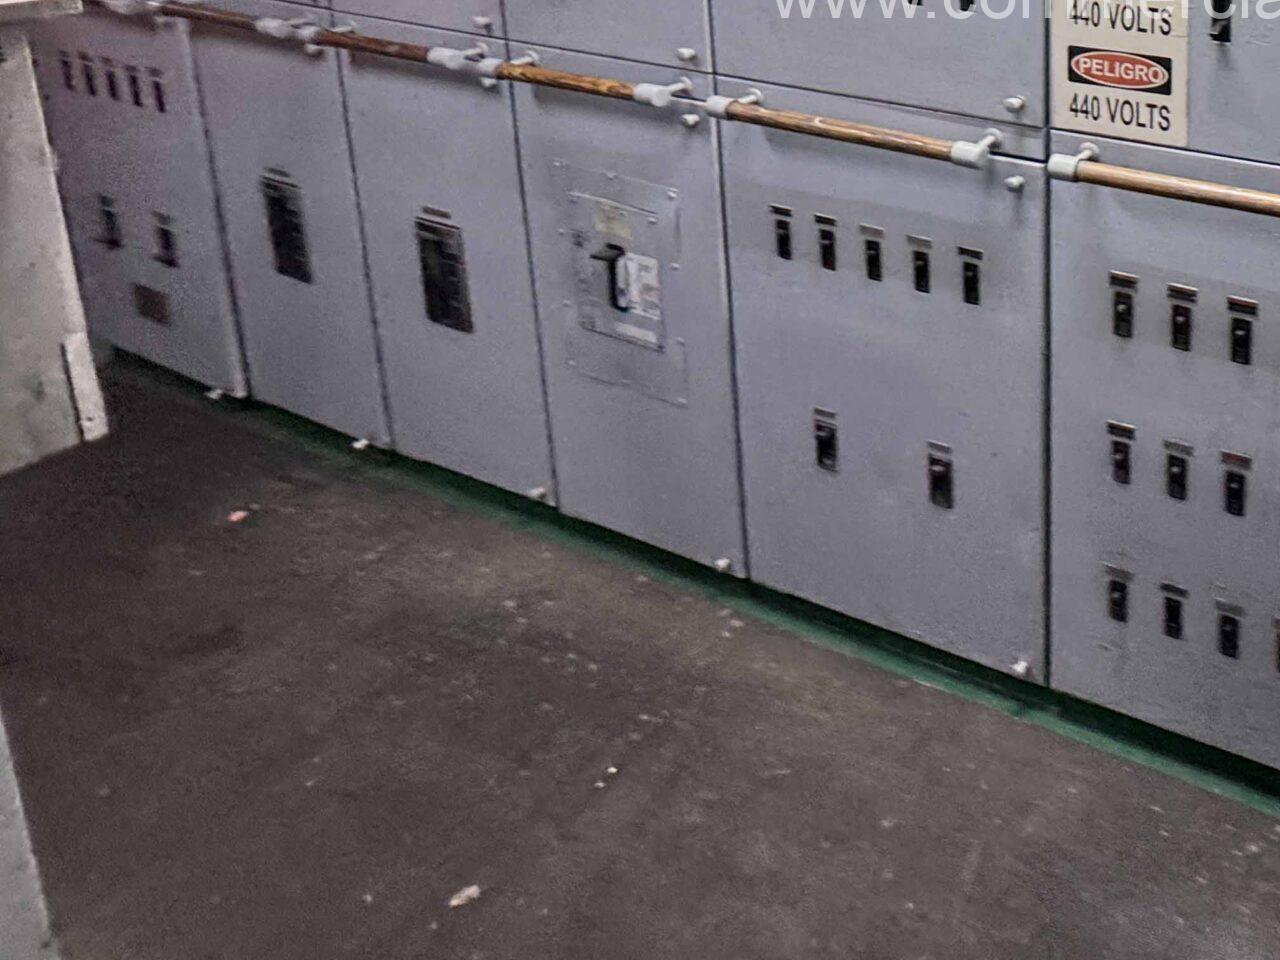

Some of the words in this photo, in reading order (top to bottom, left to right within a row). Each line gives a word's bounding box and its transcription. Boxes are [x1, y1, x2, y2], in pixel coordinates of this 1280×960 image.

[1069, 0, 1101, 28] 440
[1108, 3, 1173, 36] VOLTS
[1079, 56, 1164, 83] PELIGRO
[1069, 93, 1101, 122] 440
[1106, 97, 1171, 132] VOLTS
